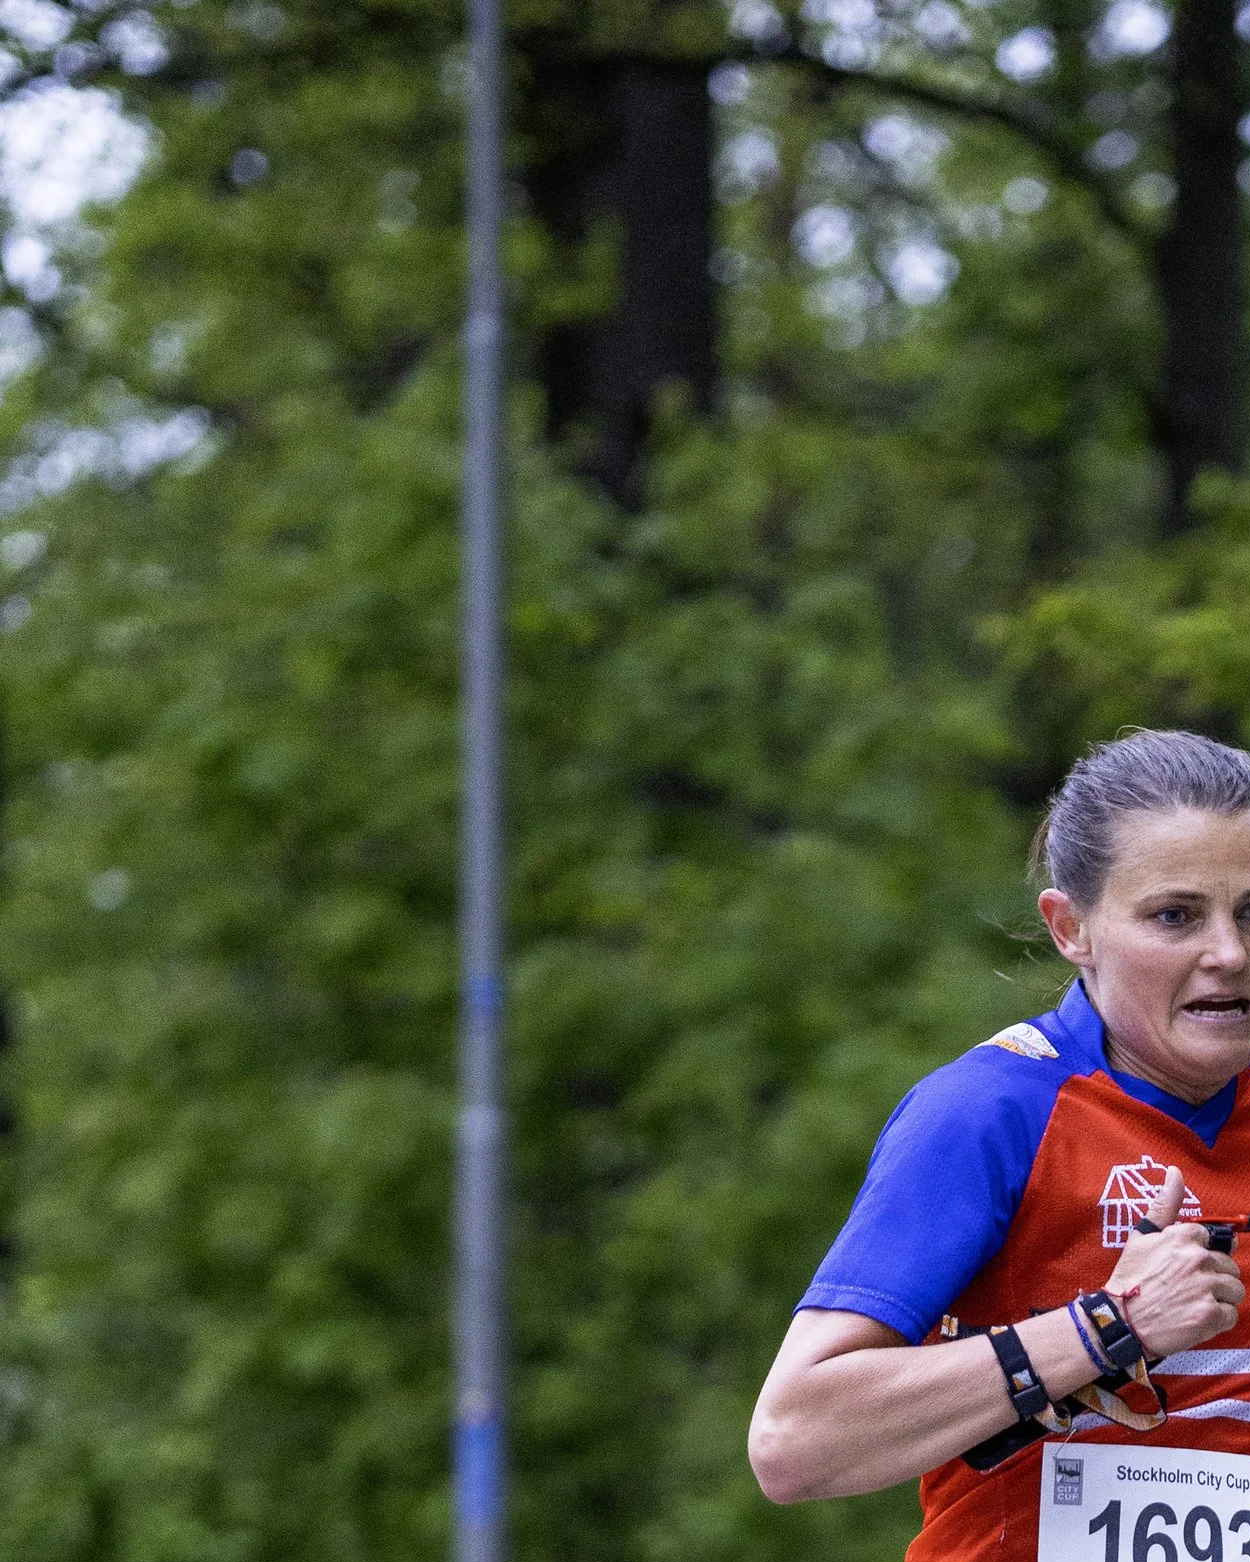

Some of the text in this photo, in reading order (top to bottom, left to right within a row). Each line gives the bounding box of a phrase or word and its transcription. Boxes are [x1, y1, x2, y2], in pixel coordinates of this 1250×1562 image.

[1116, 1465, 1193, 1484] Stockholm
[1197, 1470, 1222, 1490] City
[1226, 1473, 1250, 1493] Cup
[1057, 1485, 1079, 1493] CITY
[1057, 1493, 1079, 1501] CUP
